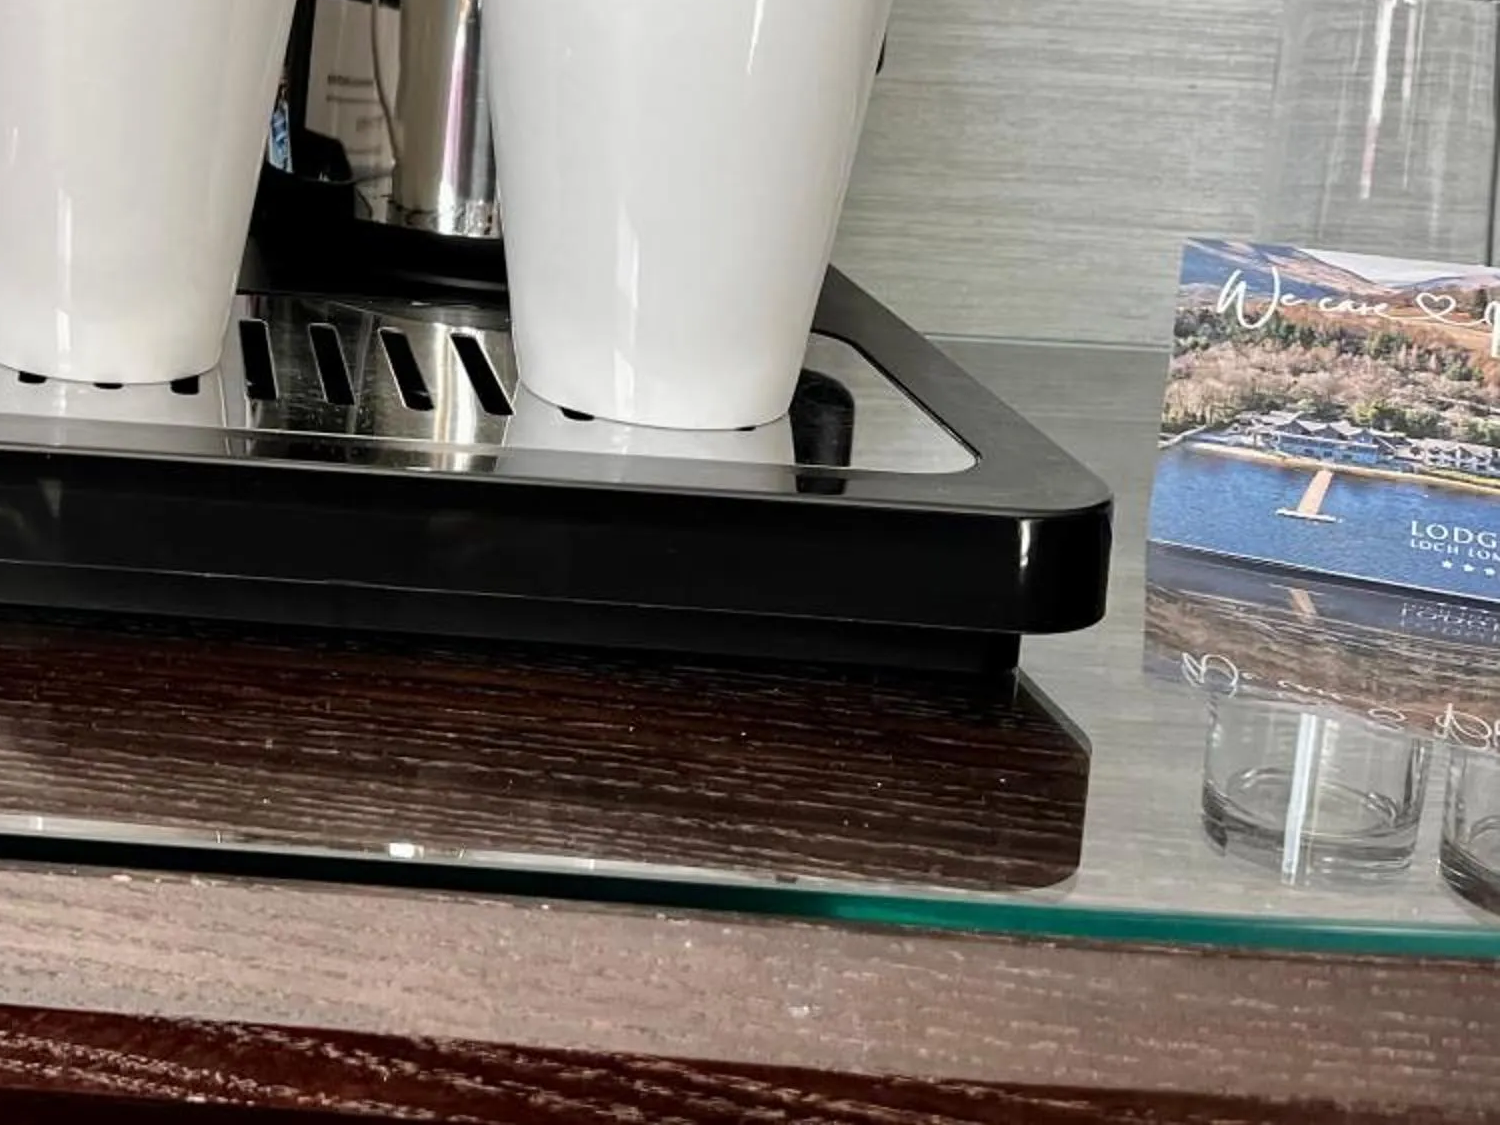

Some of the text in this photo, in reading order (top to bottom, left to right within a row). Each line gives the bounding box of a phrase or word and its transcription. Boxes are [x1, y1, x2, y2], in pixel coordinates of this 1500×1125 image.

[1216, 266, 1392, 329] We care
[1410, 538, 1459, 556] LOCH
[1411, 520, 1498, 549] LODG
